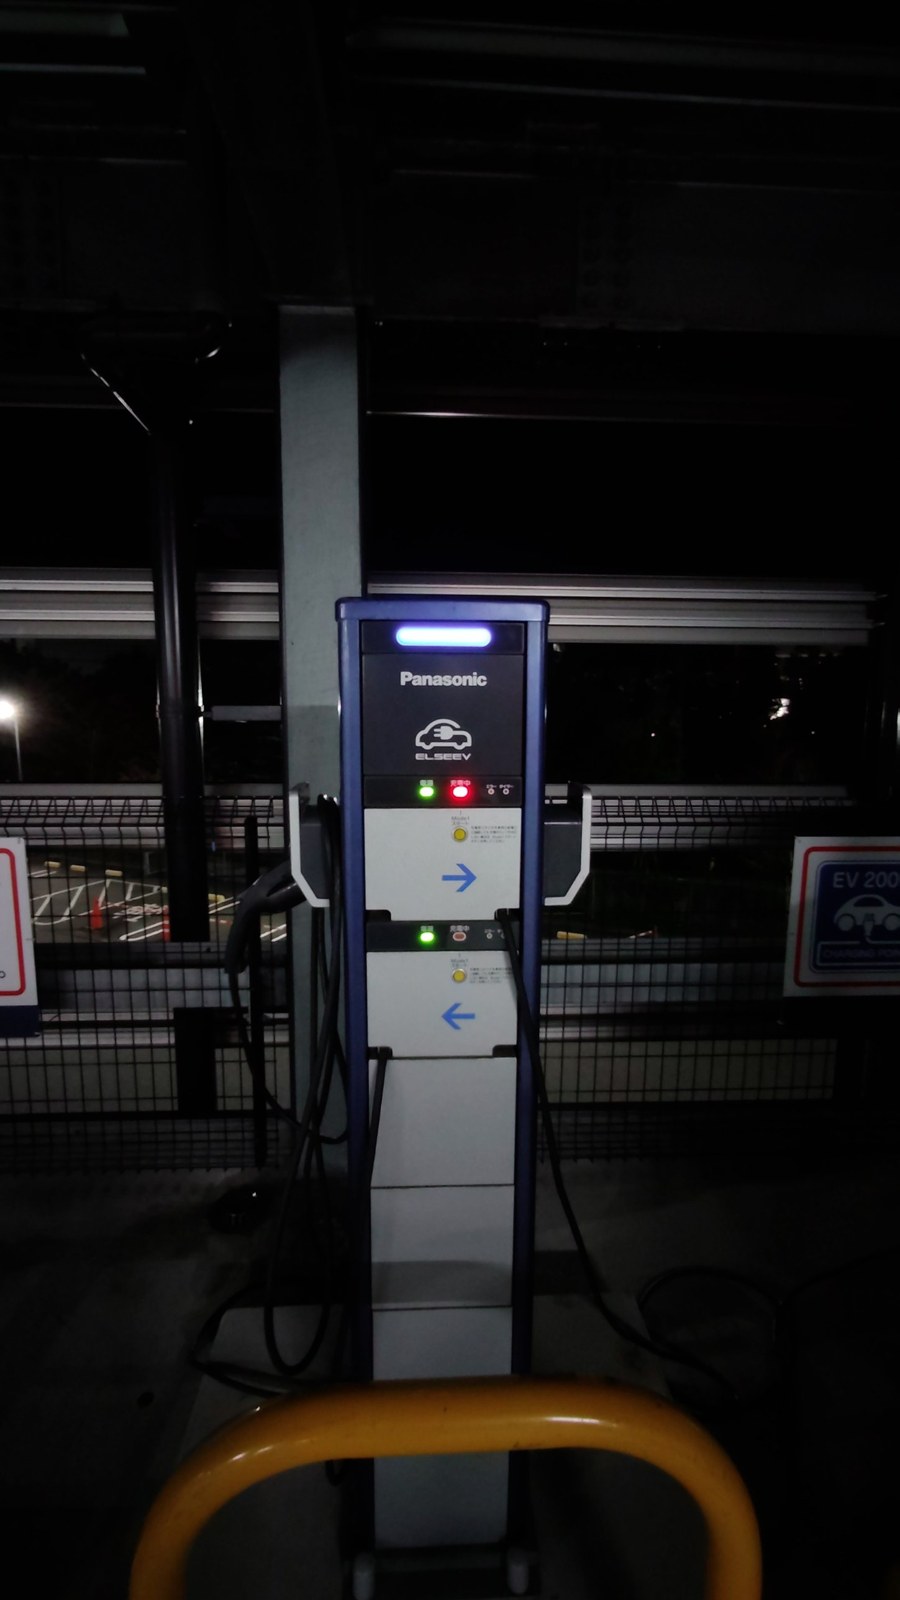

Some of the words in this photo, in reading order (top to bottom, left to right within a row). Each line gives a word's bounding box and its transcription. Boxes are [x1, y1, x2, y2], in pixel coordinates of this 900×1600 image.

[400, 671, 488, 686] Panasonic
[415, 753, 472, 761] ELSEEV
[833, 871, 860, 888] EV
